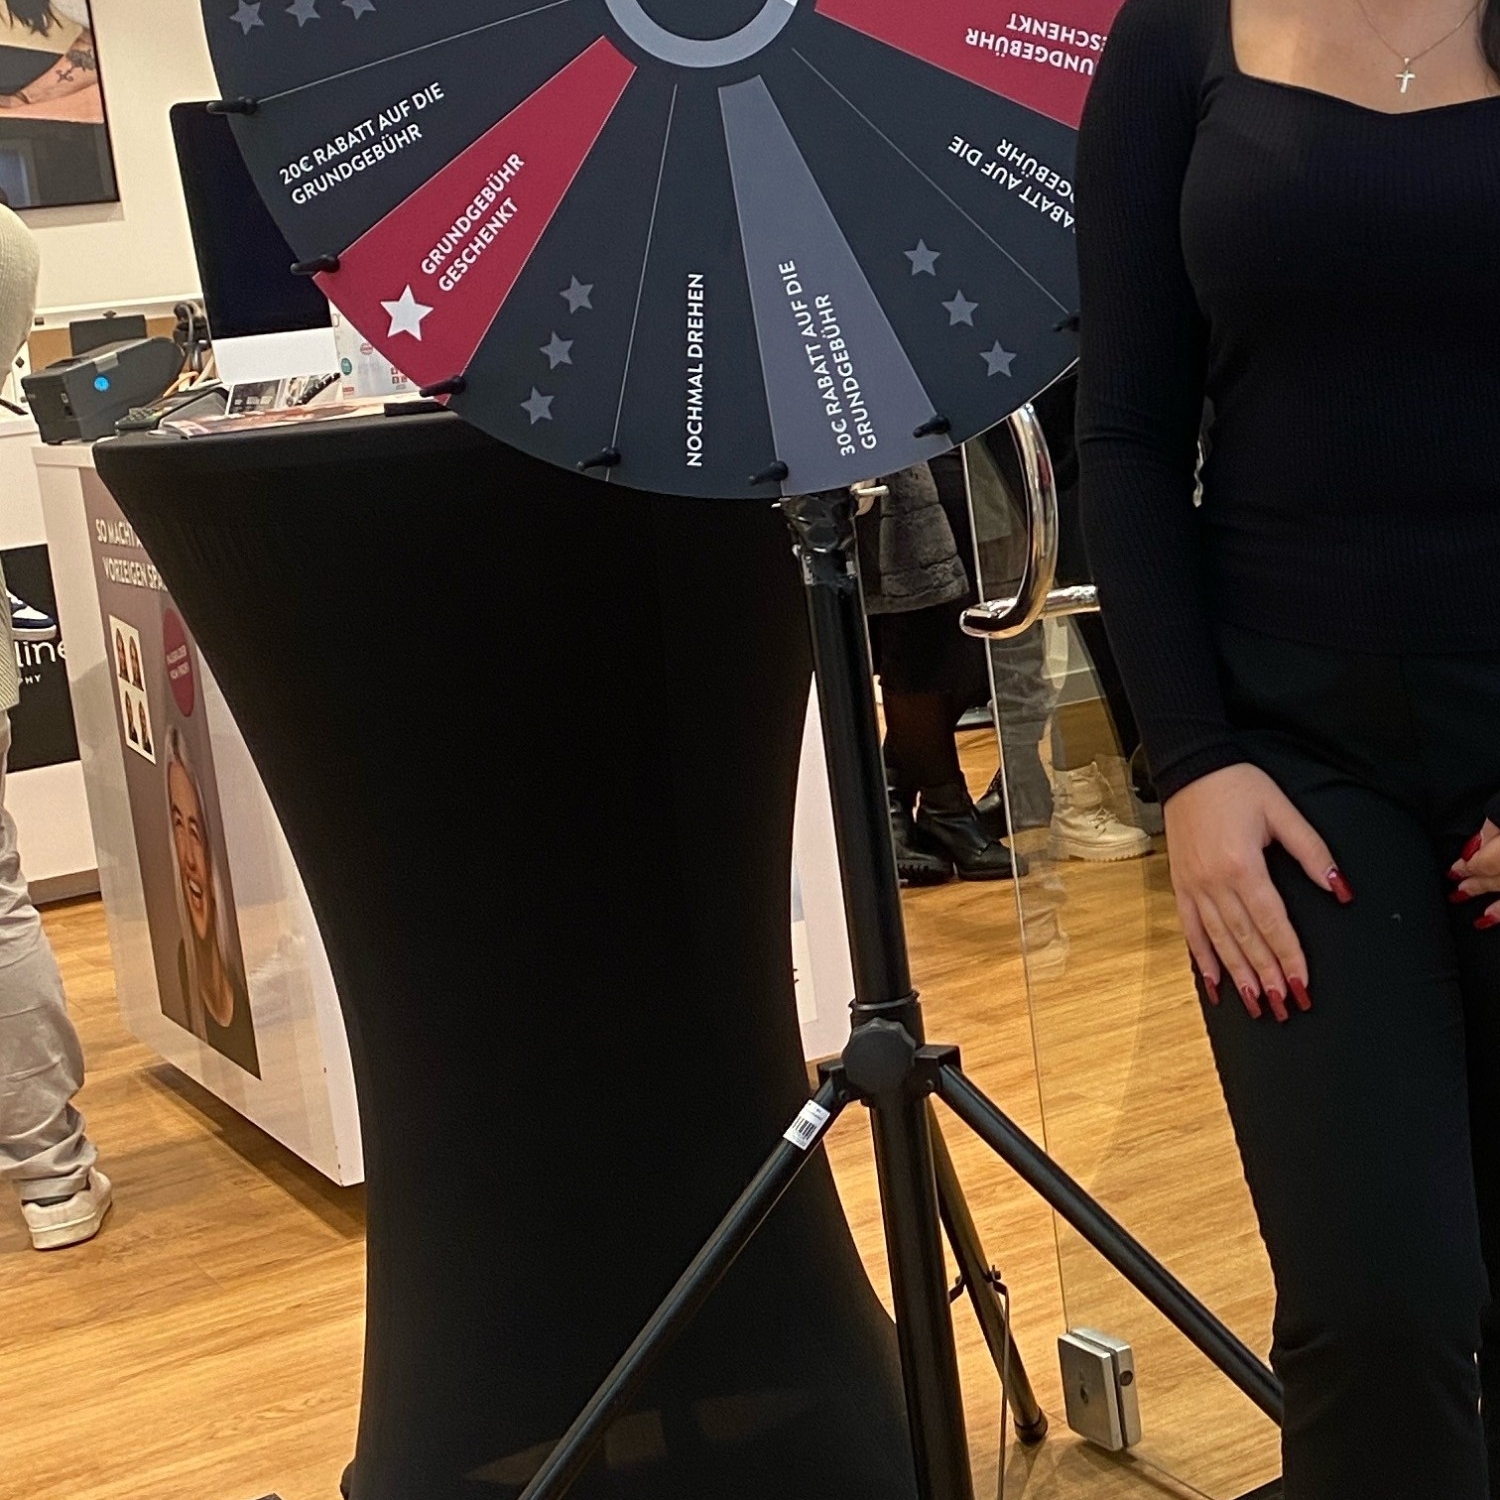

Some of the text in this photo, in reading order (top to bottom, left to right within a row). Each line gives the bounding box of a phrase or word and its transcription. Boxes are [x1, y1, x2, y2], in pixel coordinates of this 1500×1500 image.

[965, 28, 1094, 76] UNDGEBÜHR
[1006, 13, 1108, 52] SCHENKT
[292, 123, 423, 204] GRUNDGEBÜHR
[312, 119, 375, 166] RABATT
[378, 99, 410, 131] AUF
[411, 82, 444, 110] DIE
[421, 154, 525, 275] GRUNDGEBÜHR
[948, 135, 1075, 228] ABATT AUF DIE
[439, 197, 518, 291] GESCHENKT
[778, 260, 803, 296] DIE
[790, 300, 817, 337] AUF
[686, 273, 704, 467] NOCHMAL DREHEN
[805, 344, 842, 416] RABATT
[815, 294, 877, 449] GRUNDGEBÜHR
